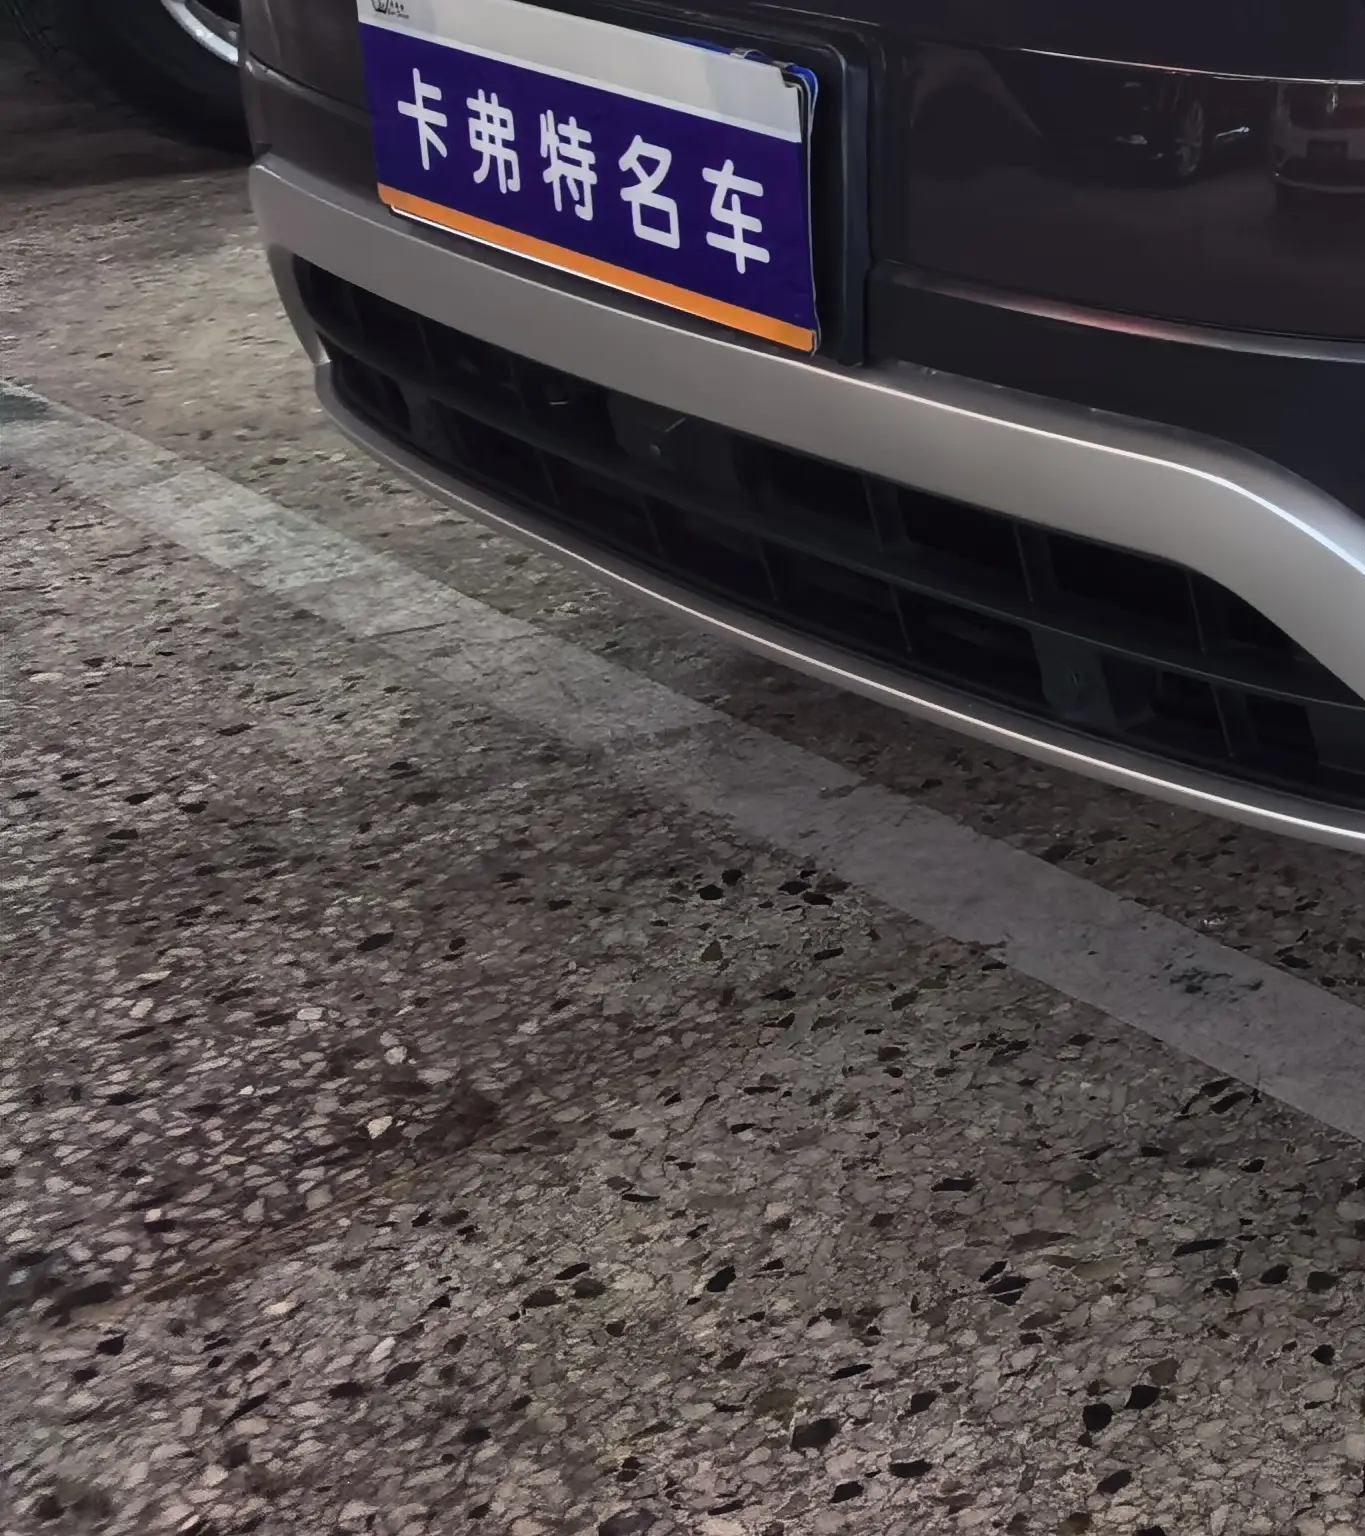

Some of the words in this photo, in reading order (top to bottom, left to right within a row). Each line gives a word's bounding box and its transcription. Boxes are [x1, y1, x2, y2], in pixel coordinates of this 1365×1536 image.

[397, 67, 771, 275] 卡弗特名车
